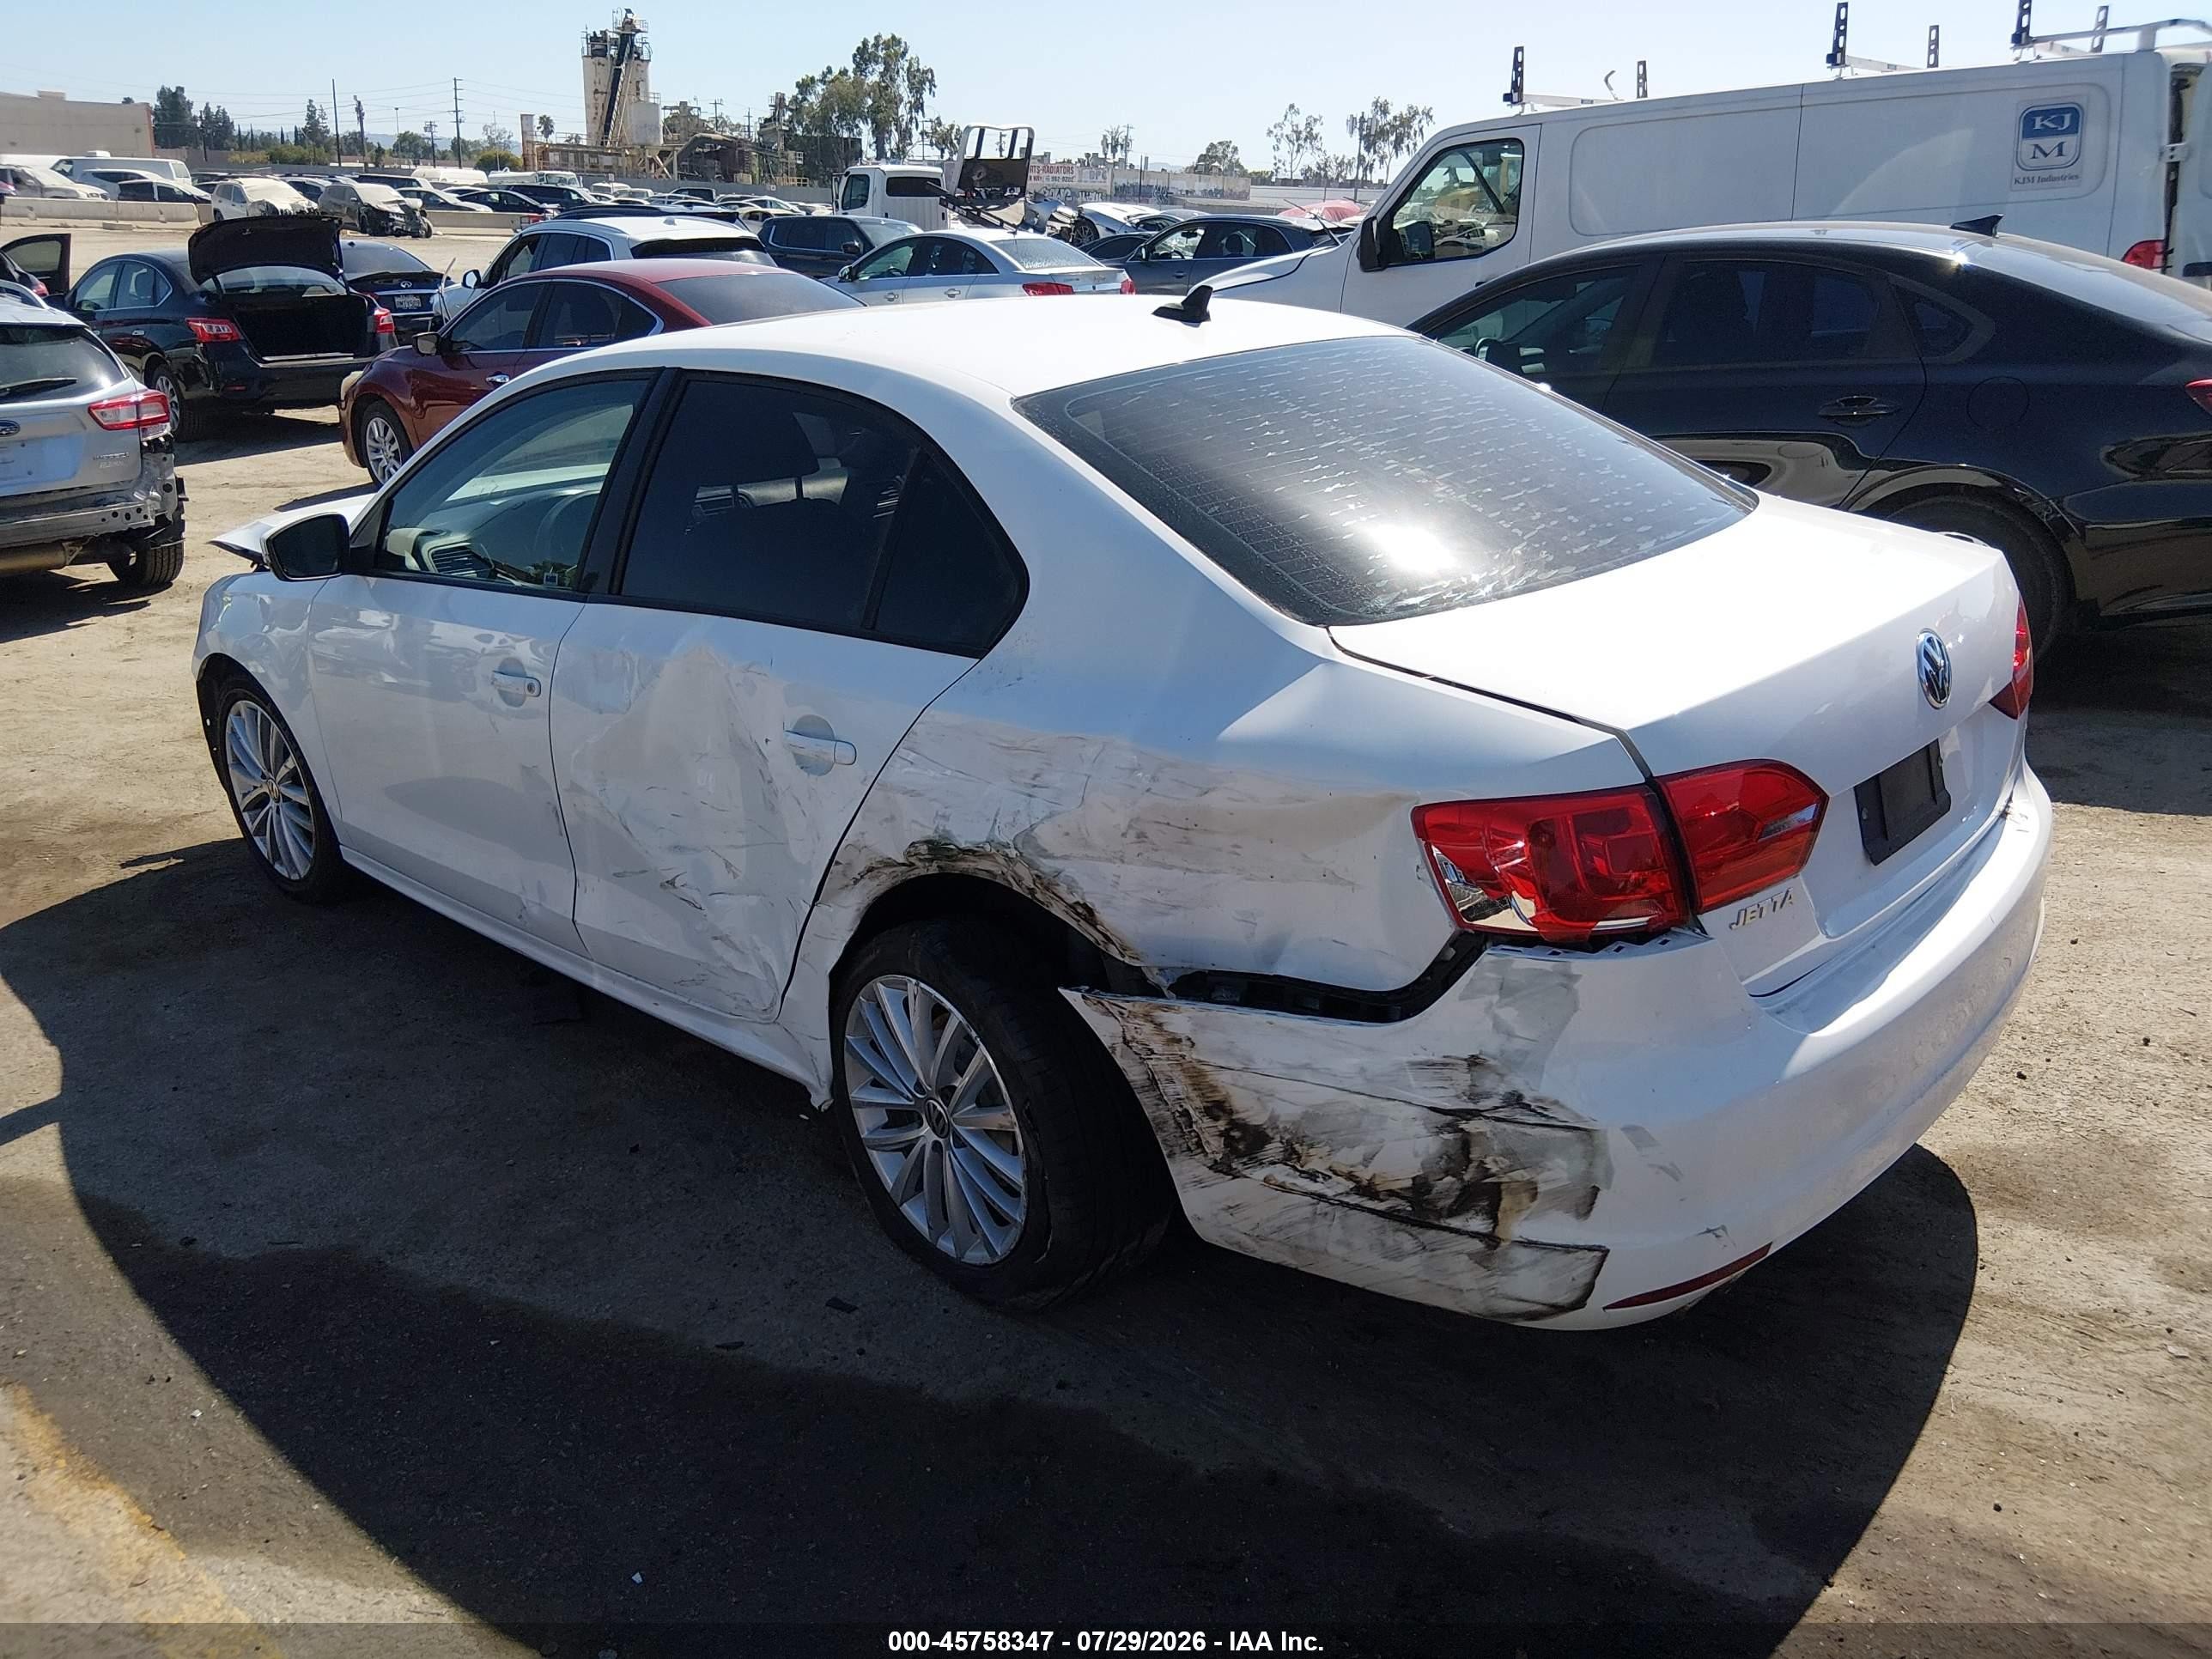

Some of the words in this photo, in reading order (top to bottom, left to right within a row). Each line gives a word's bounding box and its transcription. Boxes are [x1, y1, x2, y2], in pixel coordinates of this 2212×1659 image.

[2033, 113, 2072, 131] KJ
[2029, 141, 2068, 160] M
[2014, 176, 2035, 185] KJM
[2037, 173, 2080, 184] Industries
[1729, 887, 1795, 930] JETTA
